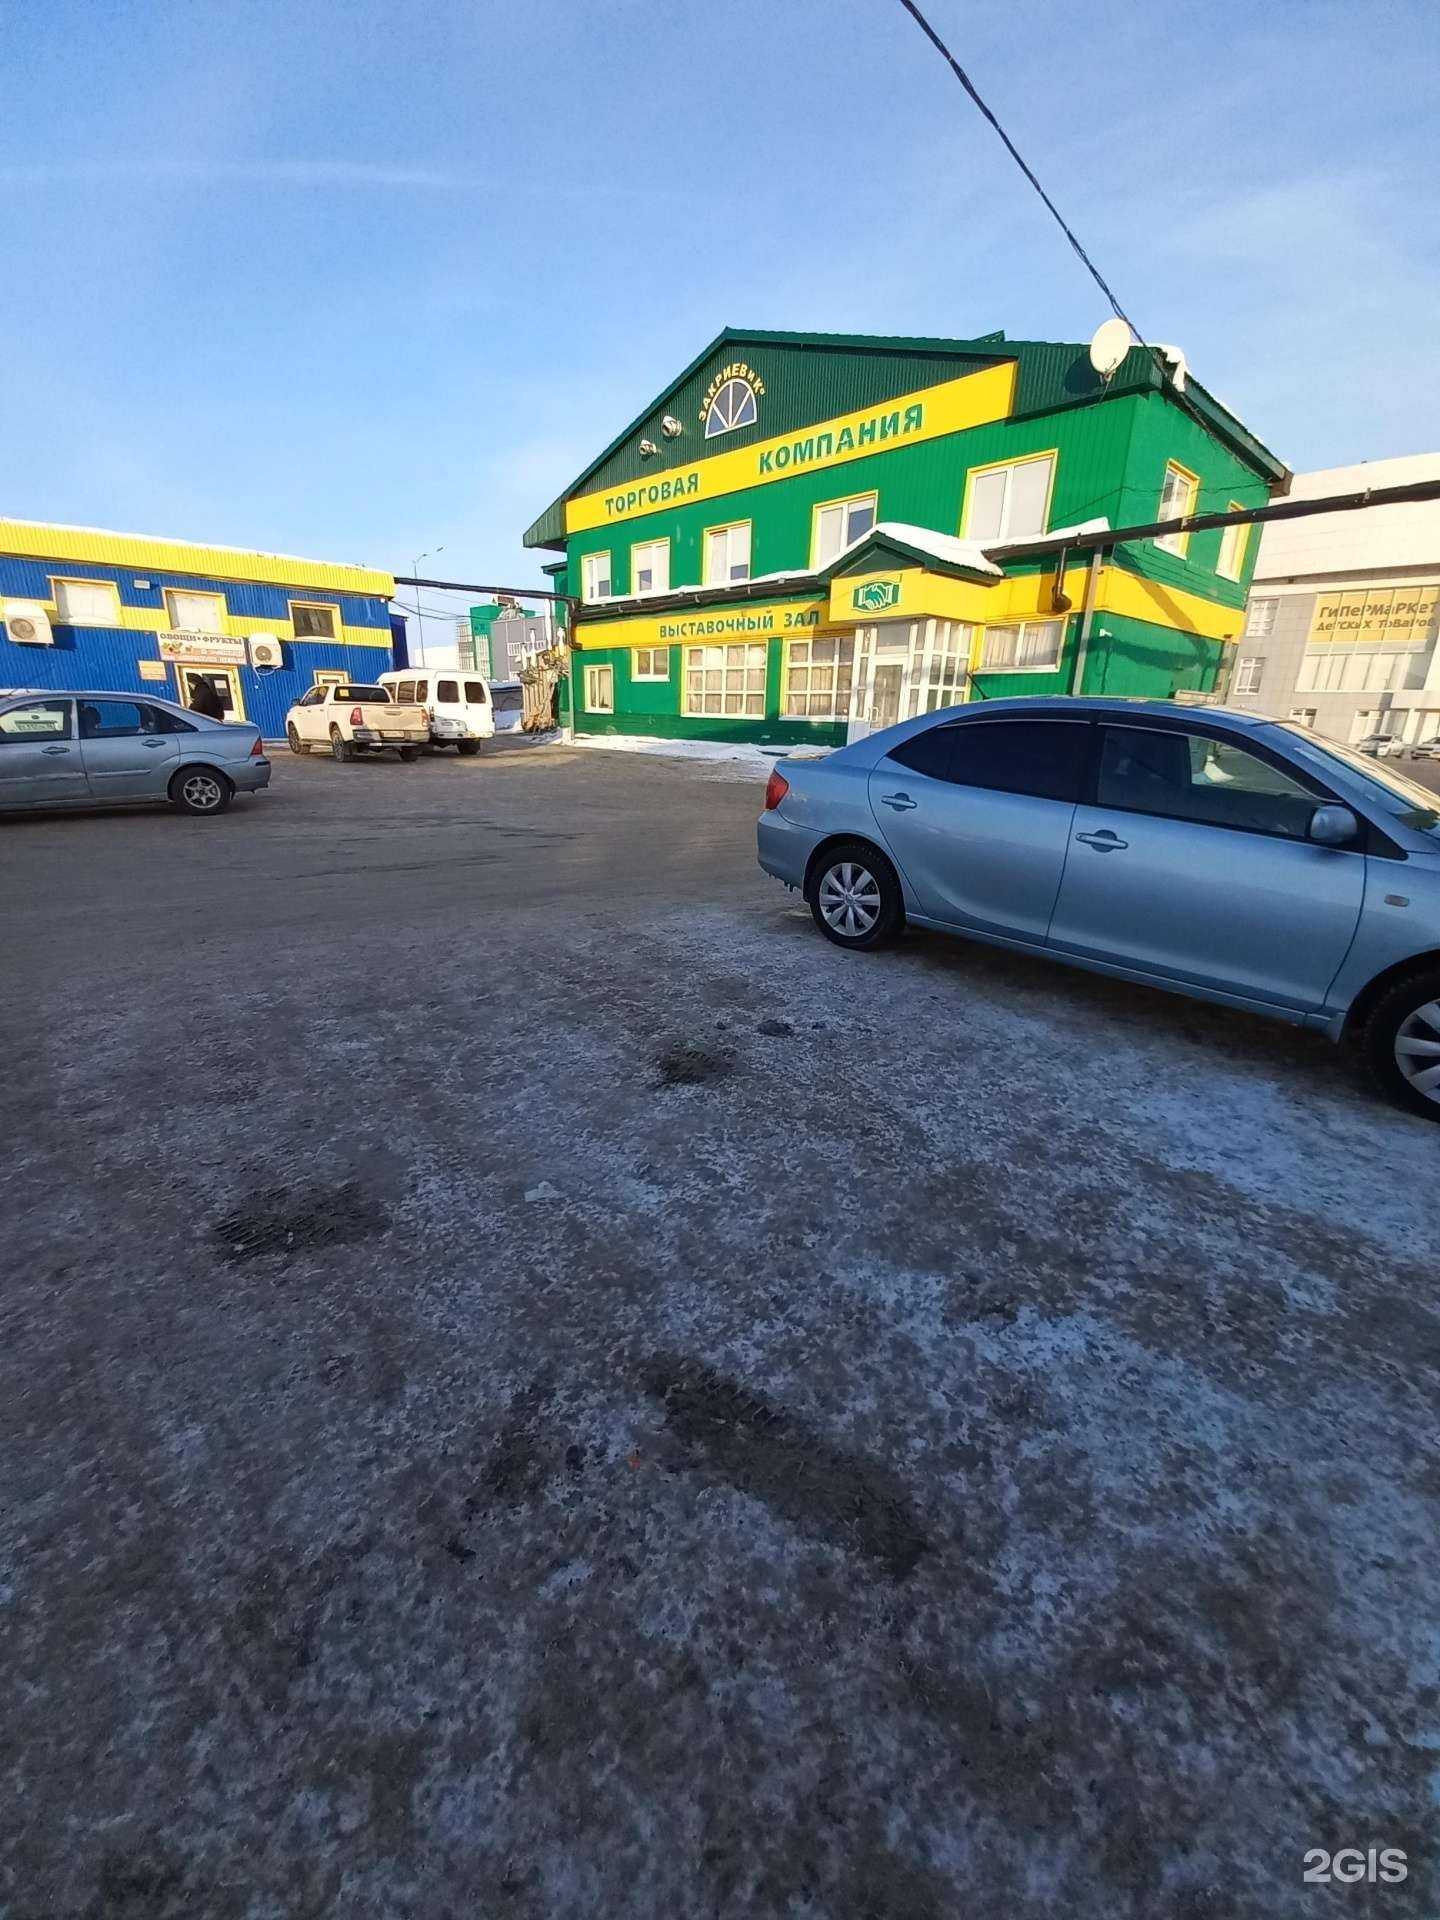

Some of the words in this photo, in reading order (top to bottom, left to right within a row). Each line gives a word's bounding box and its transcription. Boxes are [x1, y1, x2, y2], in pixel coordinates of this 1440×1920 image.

[605, 472, 700, 507] ТОРГОВАЯ
[759, 403, 924, 476] КОМПАНИЯ
[659, 609, 774, 639] ВЫСТАВОЧНЫЙ
[783, 610, 820, 628] ЗАЛ
